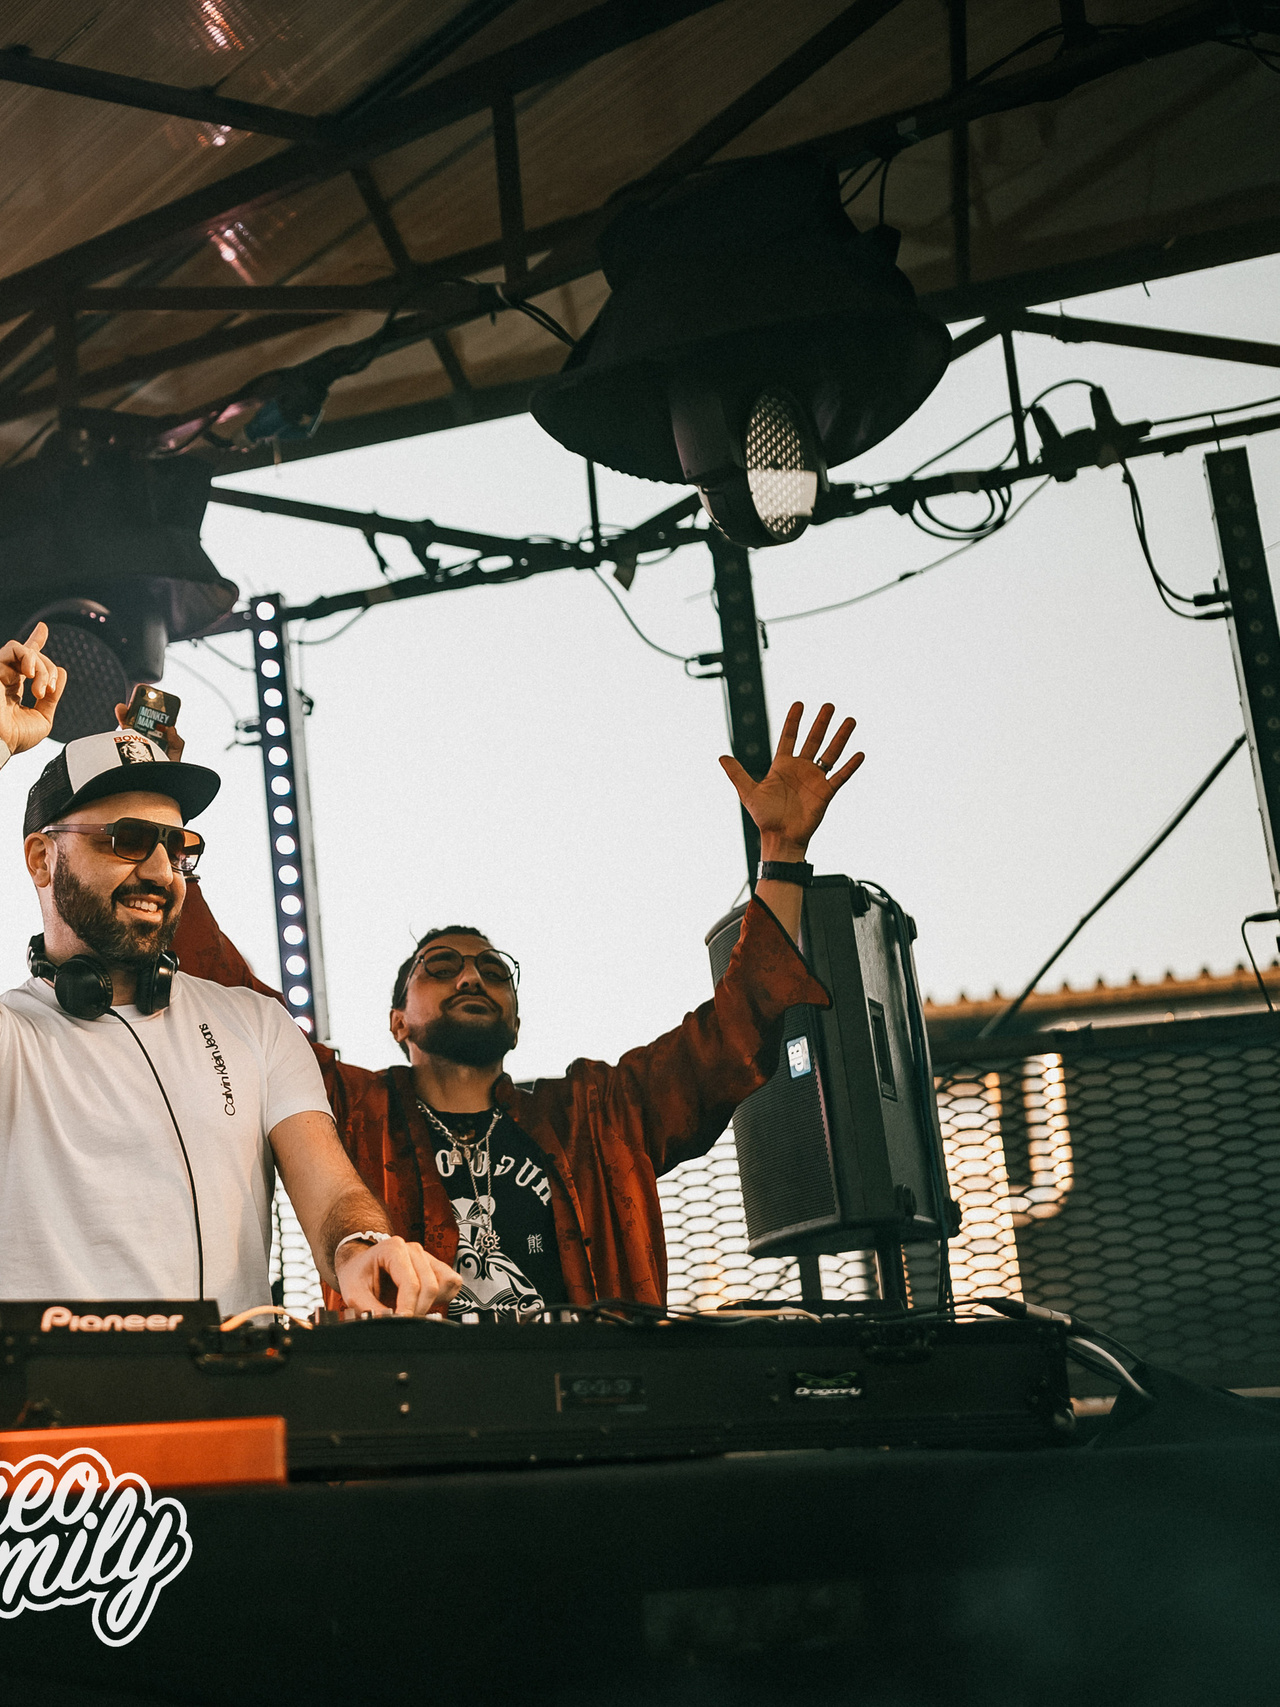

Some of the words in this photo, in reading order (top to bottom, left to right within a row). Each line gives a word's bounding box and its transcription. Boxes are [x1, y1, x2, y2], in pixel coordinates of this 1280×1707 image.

[140, 705, 170, 724] MONKEY
[199, 1023, 219, 1050] Jeans
[211, 1050, 228, 1075] Klein
[220, 1076, 236, 1116] Calvin
[527, 1234, 544, 1254] 熊
[41, 1306, 183, 1332] Pioneer
